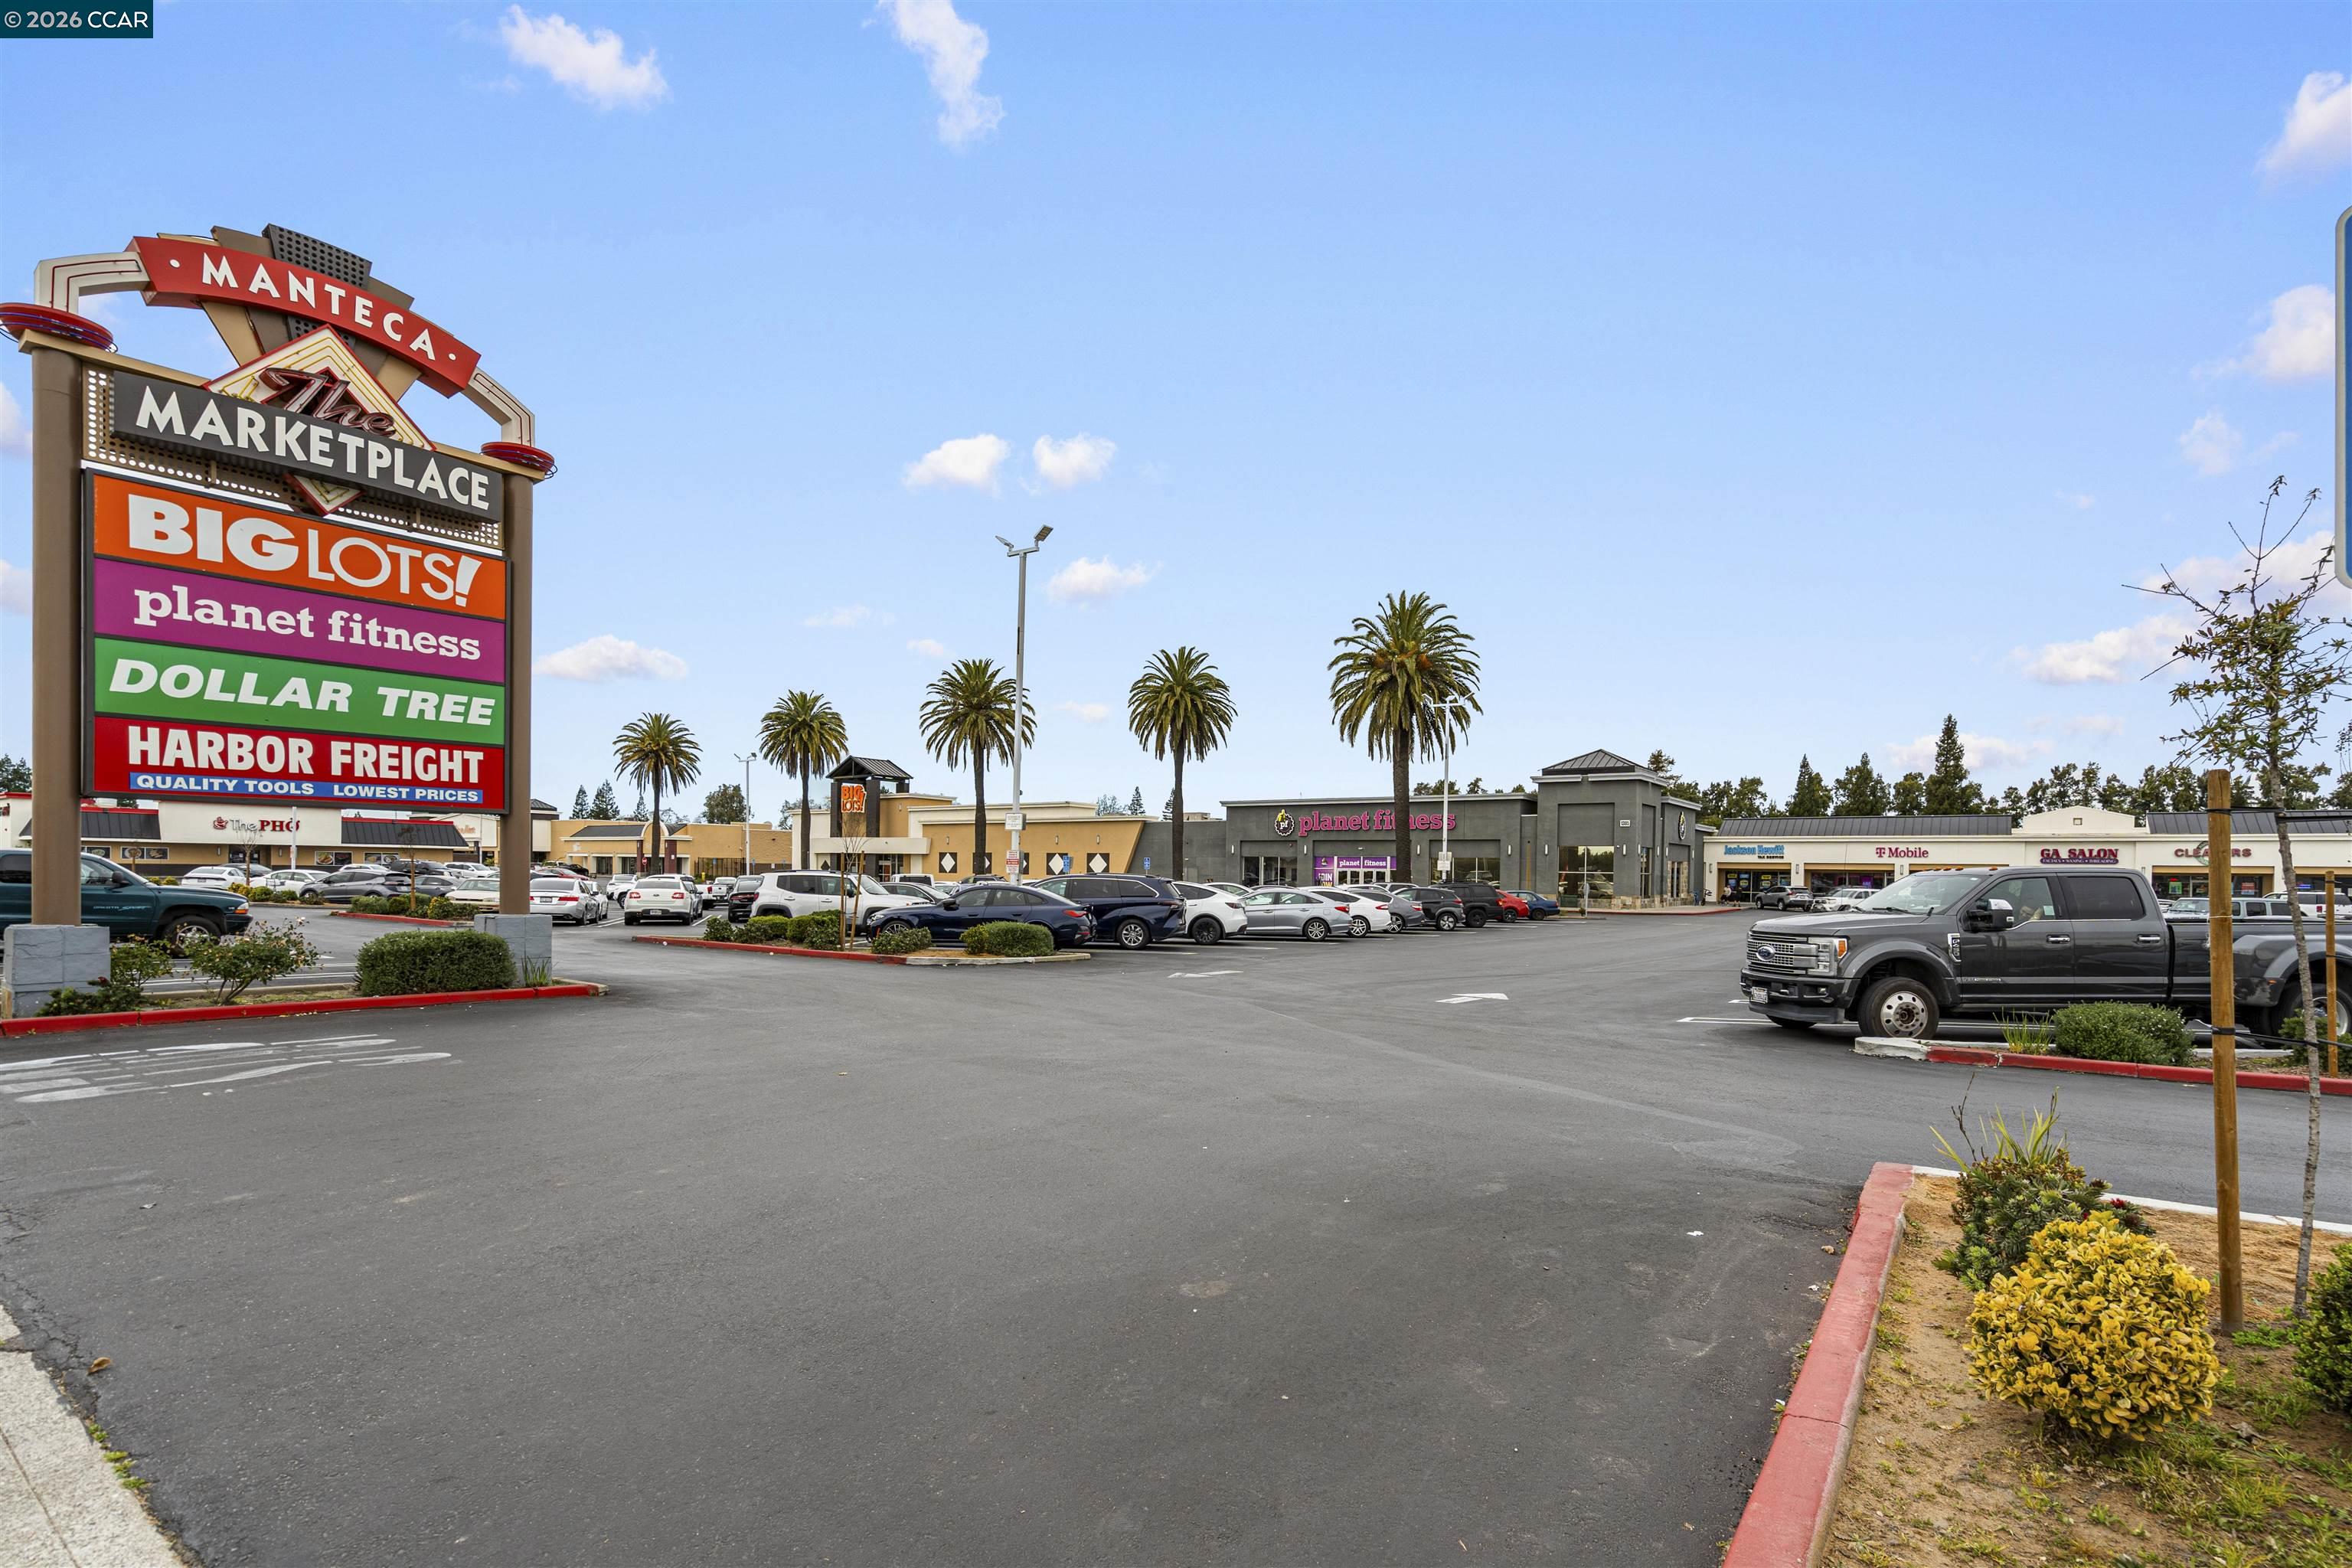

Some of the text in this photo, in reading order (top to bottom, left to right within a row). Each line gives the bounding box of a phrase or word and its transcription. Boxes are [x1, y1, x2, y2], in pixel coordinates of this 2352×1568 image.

[202, 252, 436, 361] MANTECA
[259, 368, 397, 436] The
[136, 385, 490, 510] MARKETPLACE
[128, 494, 482, 607] BIG LOTS!
[133, 585, 481, 660] planet fitness
[109, 658, 495, 726] DOLLAR TREE
[128, 726, 483, 783] HARBOR FREIGHT
[137, 775, 314, 795] QUALITY TOOLS
[334, 785, 479, 802] LOWEST PRICES
[842, 786, 864, 800] BIG
[1298, 811, 1369, 836] planet
[1888, 848, 1929, 858] Mobile
[2040, 848, 2119, 858] GA SALON
[2174, 848, 2252, 858] CLEARS
